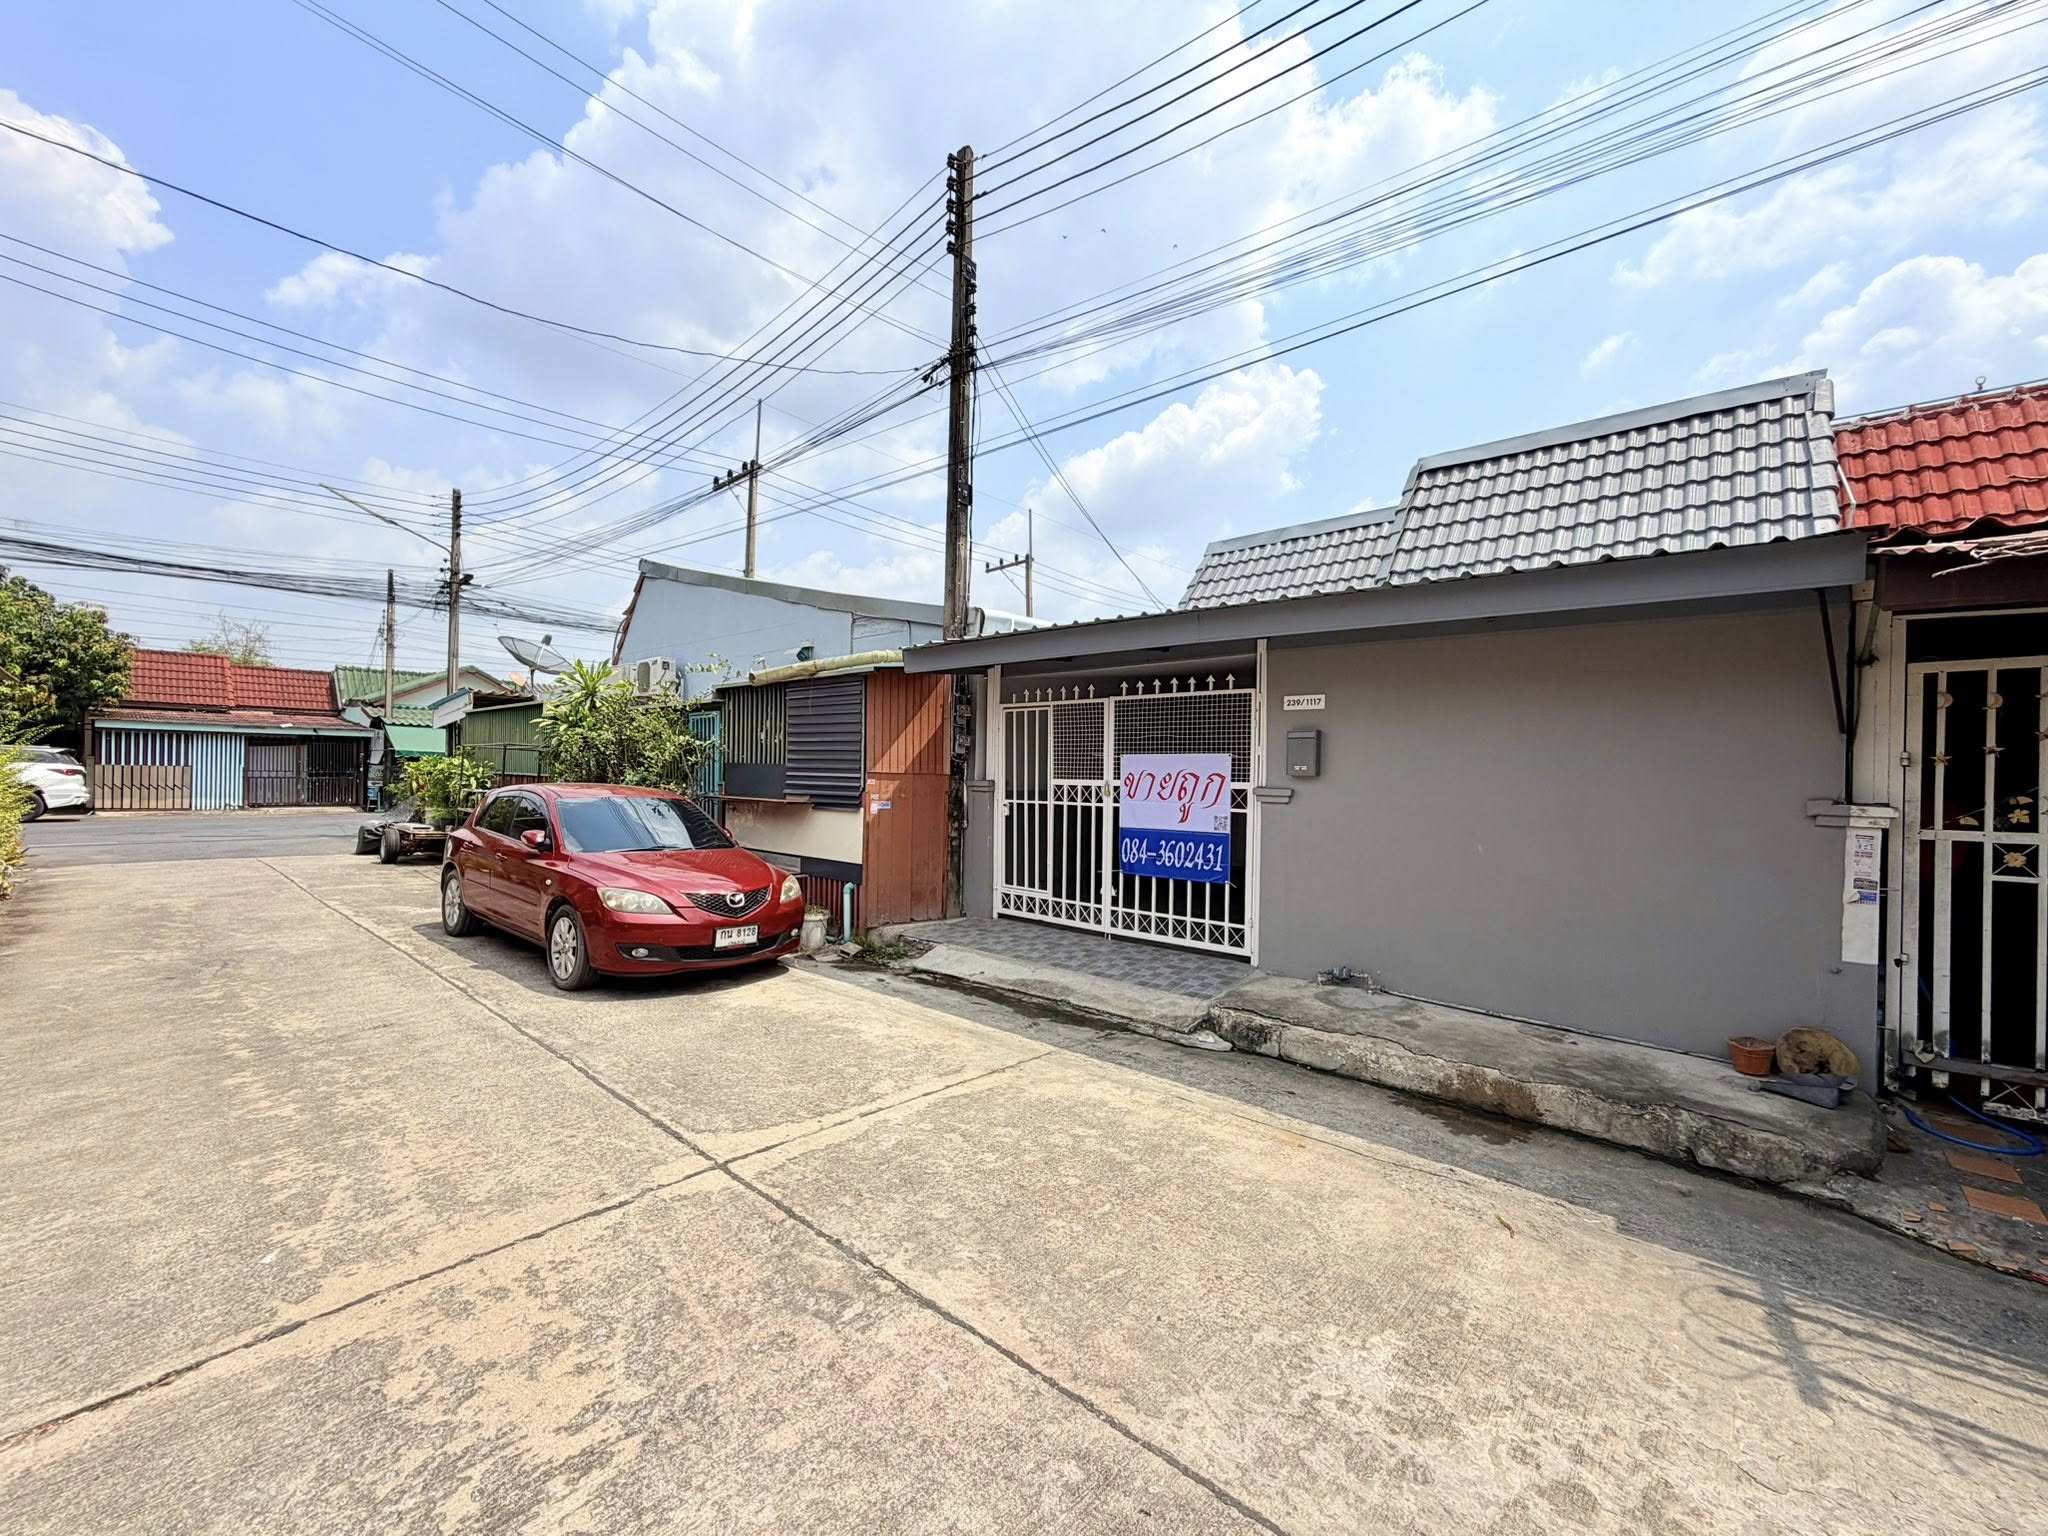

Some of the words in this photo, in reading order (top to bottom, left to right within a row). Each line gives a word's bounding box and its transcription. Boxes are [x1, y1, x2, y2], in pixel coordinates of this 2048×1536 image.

[1286, 698, 1322, 706] 239/1117
[1124, 769, 1226, 824] ขายถูก
[1122, 838, 1222, 872] 084-3602431
